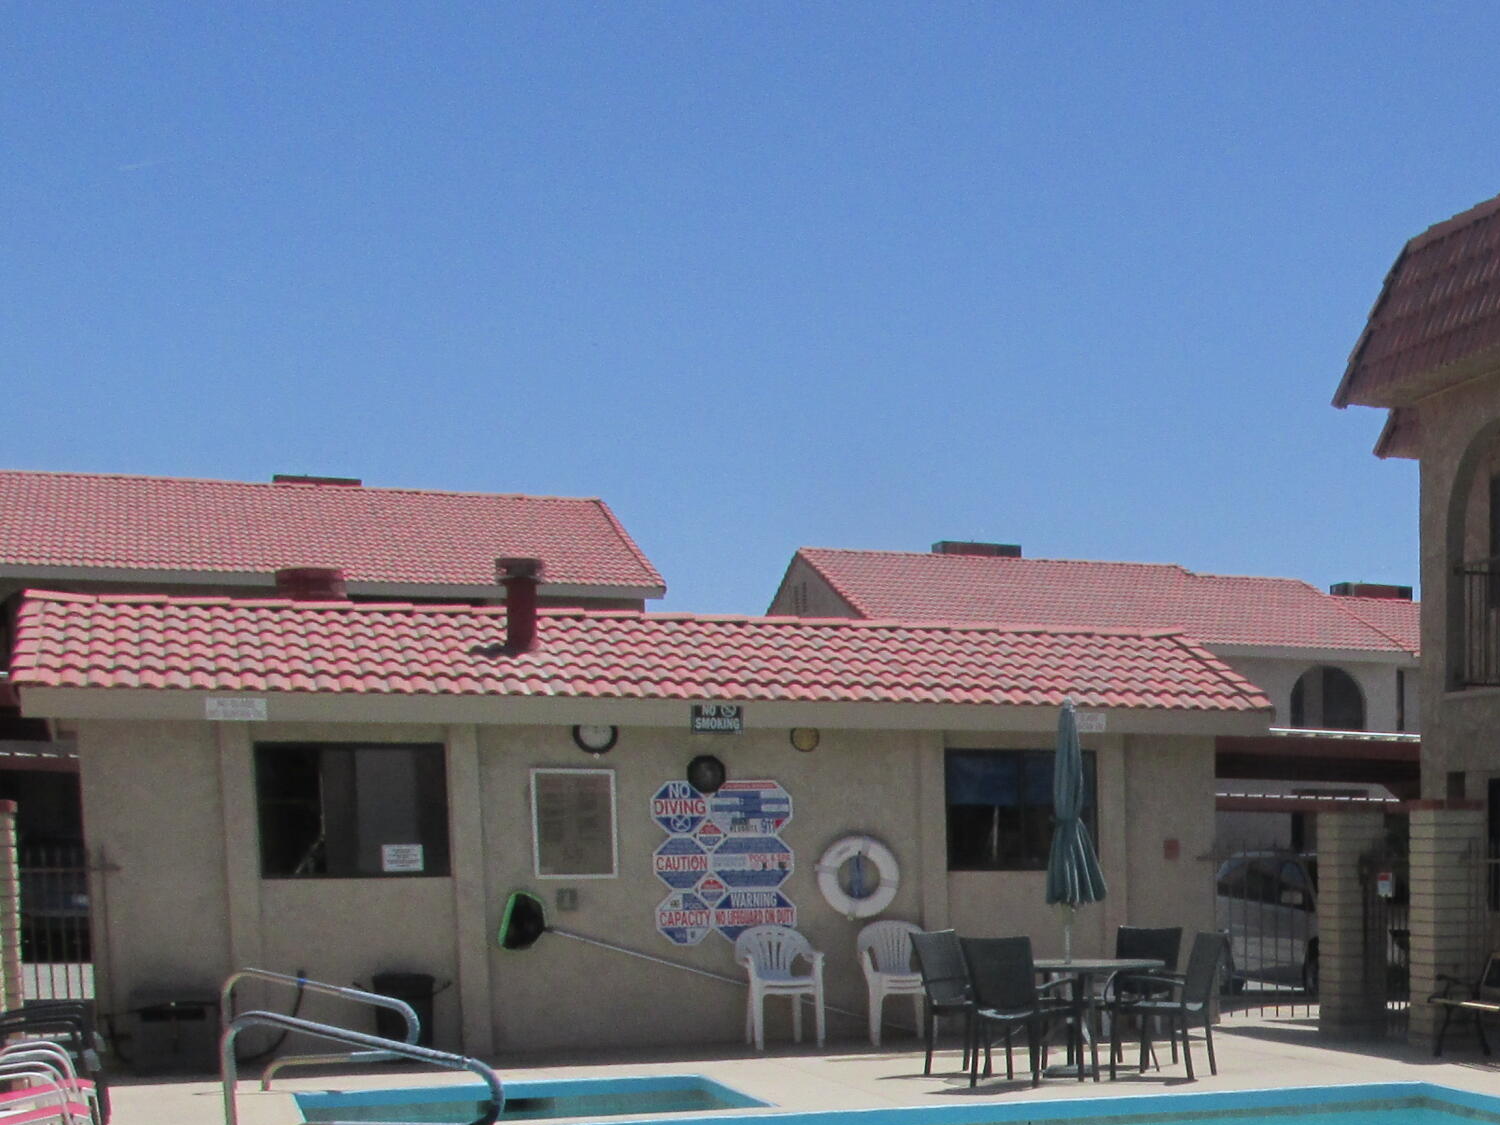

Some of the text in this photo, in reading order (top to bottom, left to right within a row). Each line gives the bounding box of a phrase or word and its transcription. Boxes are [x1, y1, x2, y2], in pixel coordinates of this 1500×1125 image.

[702, 704, 716, 716] NO
[695, 717, 740, 729] SMOKING
[669, 784, 690, 798] NO
[655, 800, 706, 815] DIVING
[656, 856, 708, 871] CAUTION
[731, 892, 777, 908] WARNING
[659, 911, 711, 927] CAPACITY
[716, 909, 794, 925] NO LIFEGUARD ON DUTY
